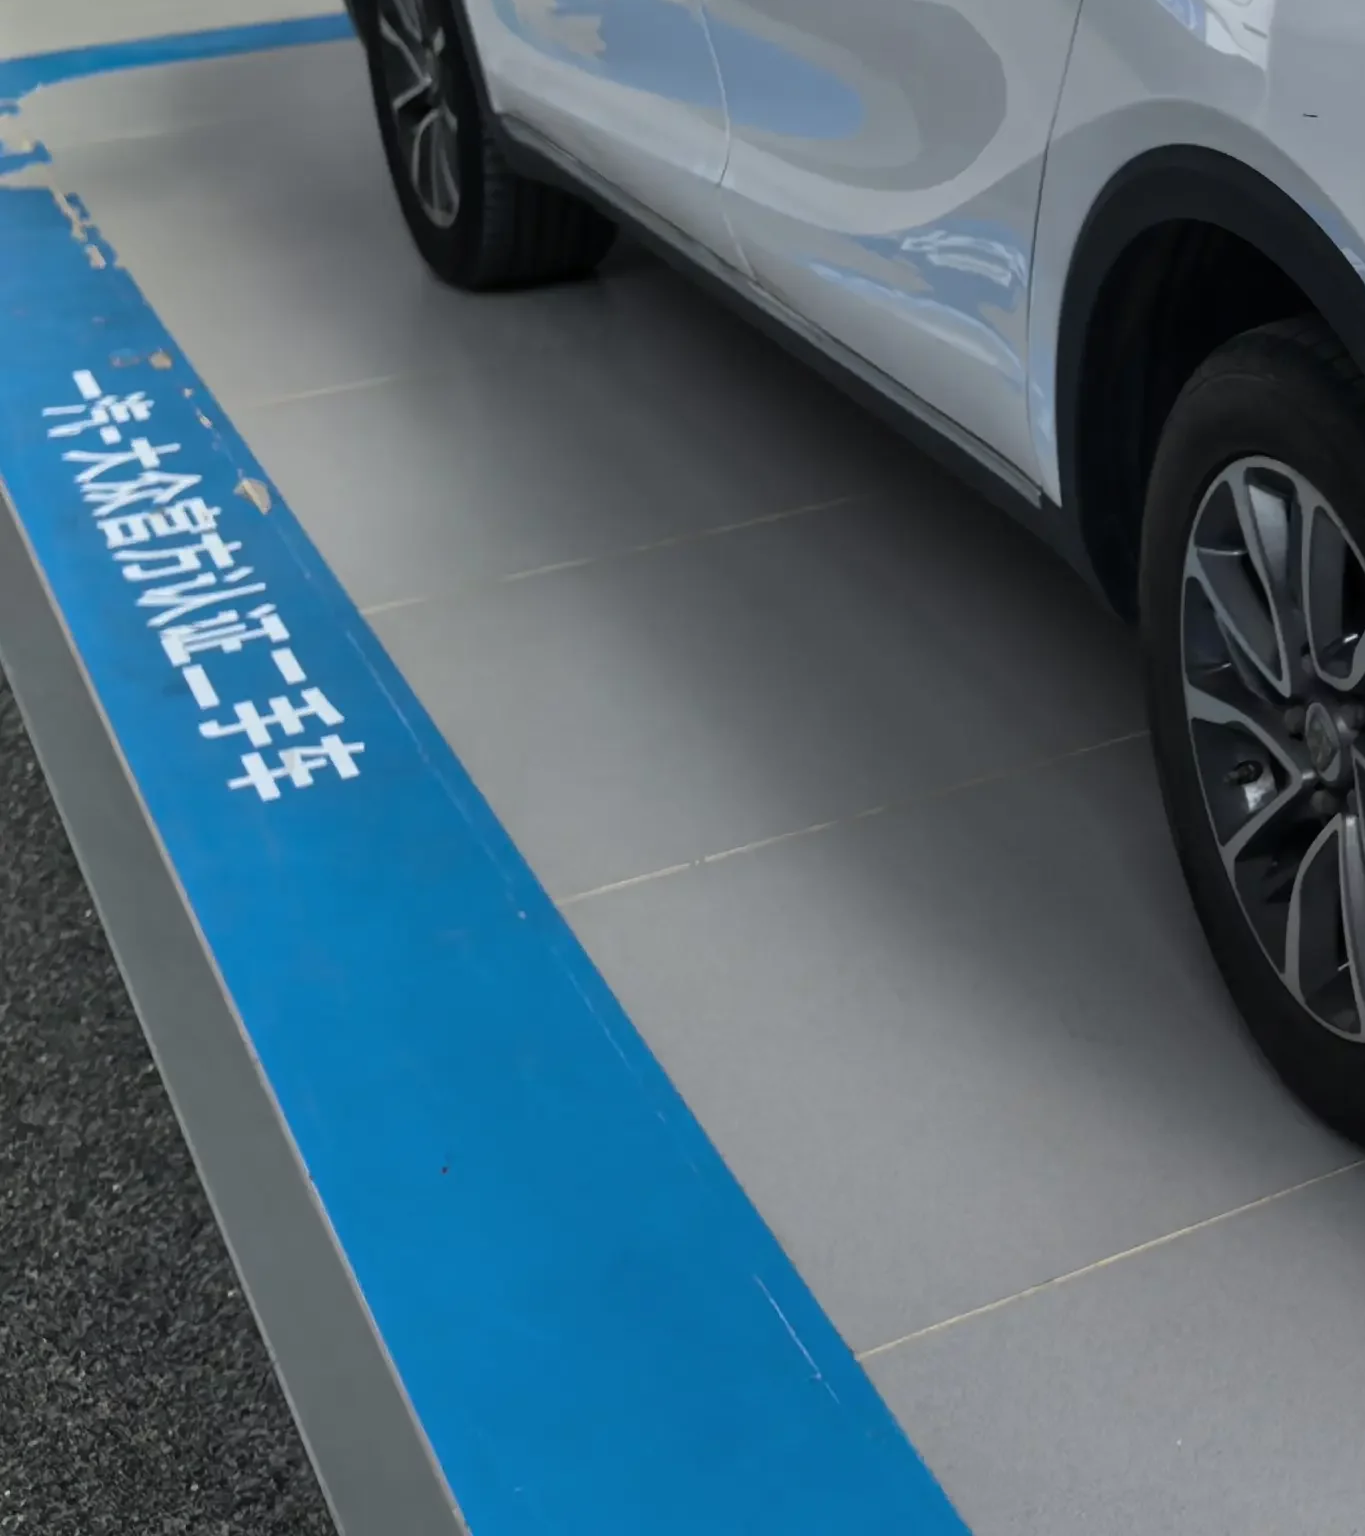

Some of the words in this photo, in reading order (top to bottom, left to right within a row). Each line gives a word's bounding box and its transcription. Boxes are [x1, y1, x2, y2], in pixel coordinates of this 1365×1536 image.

[42, 369, 365, 803] 一汽大众官方认证二手车
